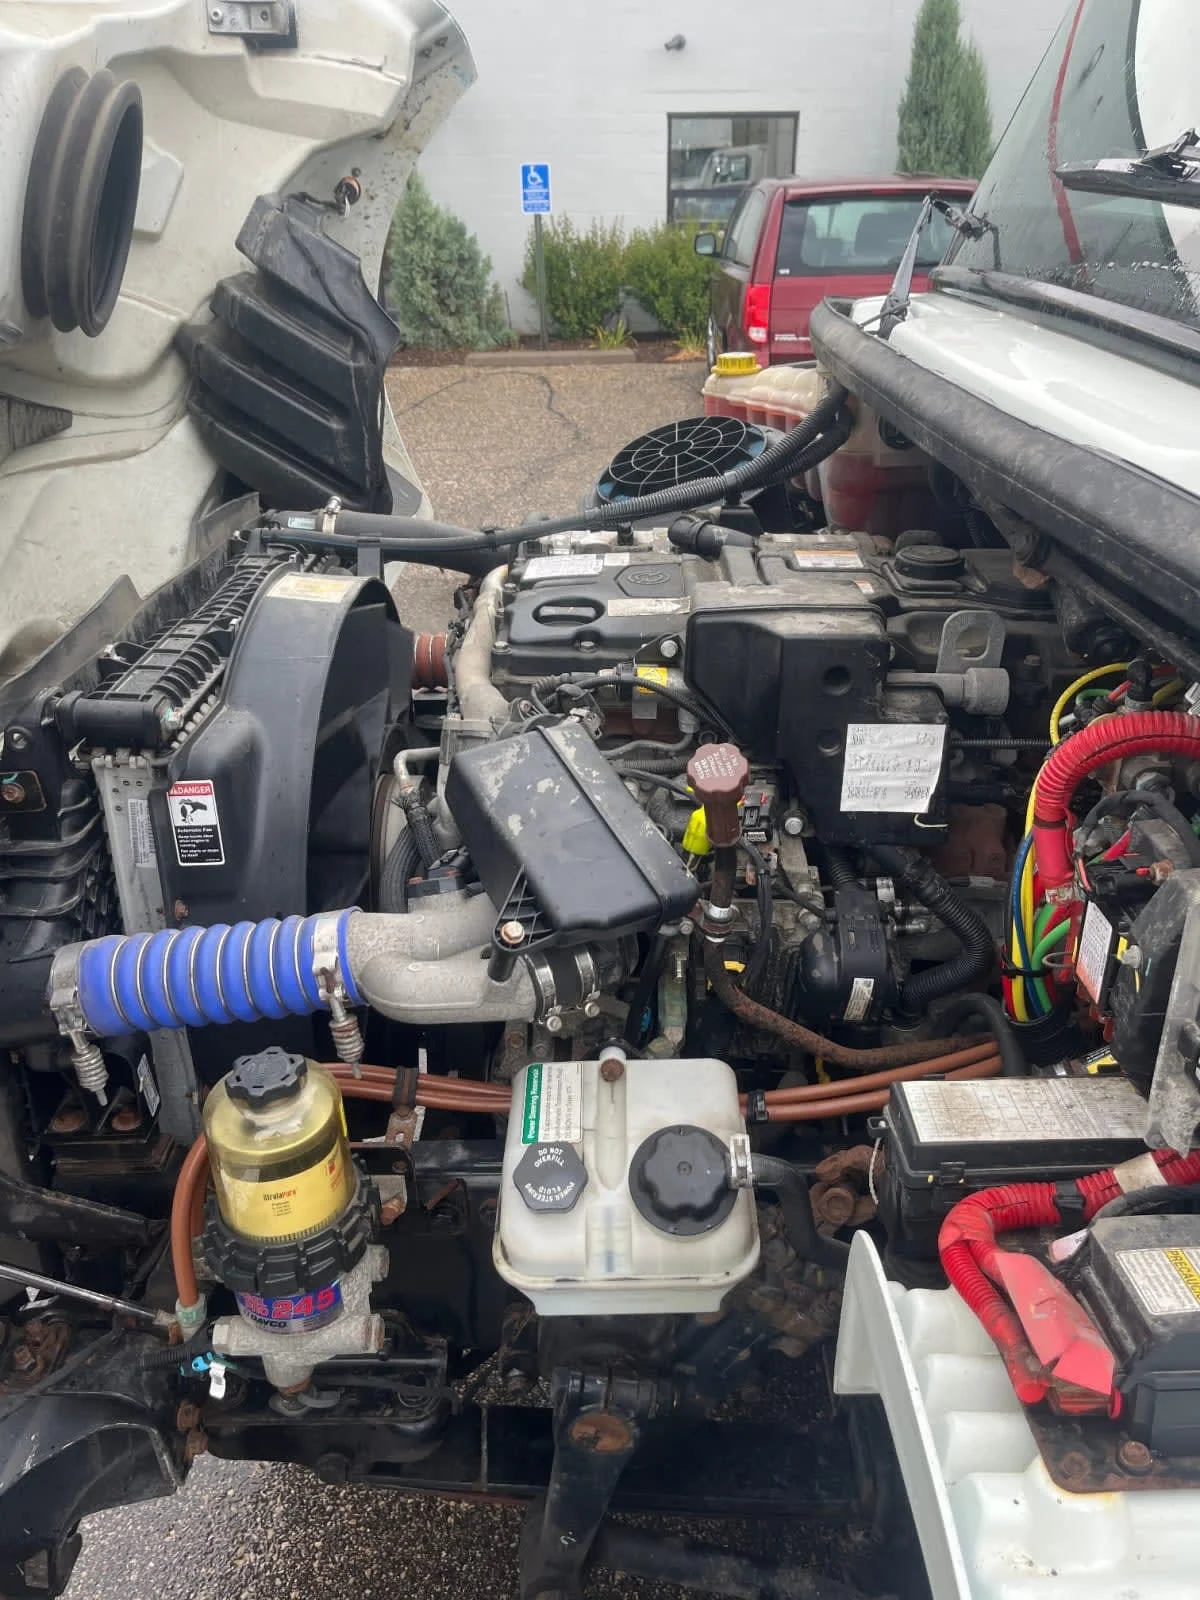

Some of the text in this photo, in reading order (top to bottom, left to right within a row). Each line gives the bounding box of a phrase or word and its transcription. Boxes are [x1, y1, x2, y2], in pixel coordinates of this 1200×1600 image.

[177, 785, 211, 794] DANGER
[529, 1095, 539, 1120] Steering
[528, 1120, 536, 1139] Power
[538, 1147, 564, 1157] DO NOT
[534, 1154, 565, 1168] OVERFILL
[524, 1181, 576, 1203] POWER STEERING
[538, 1185, 562, 1196] FLUID
[272, 1287, 334, 1320] 245
[250, 1314, 287, 1328] DAVCO
